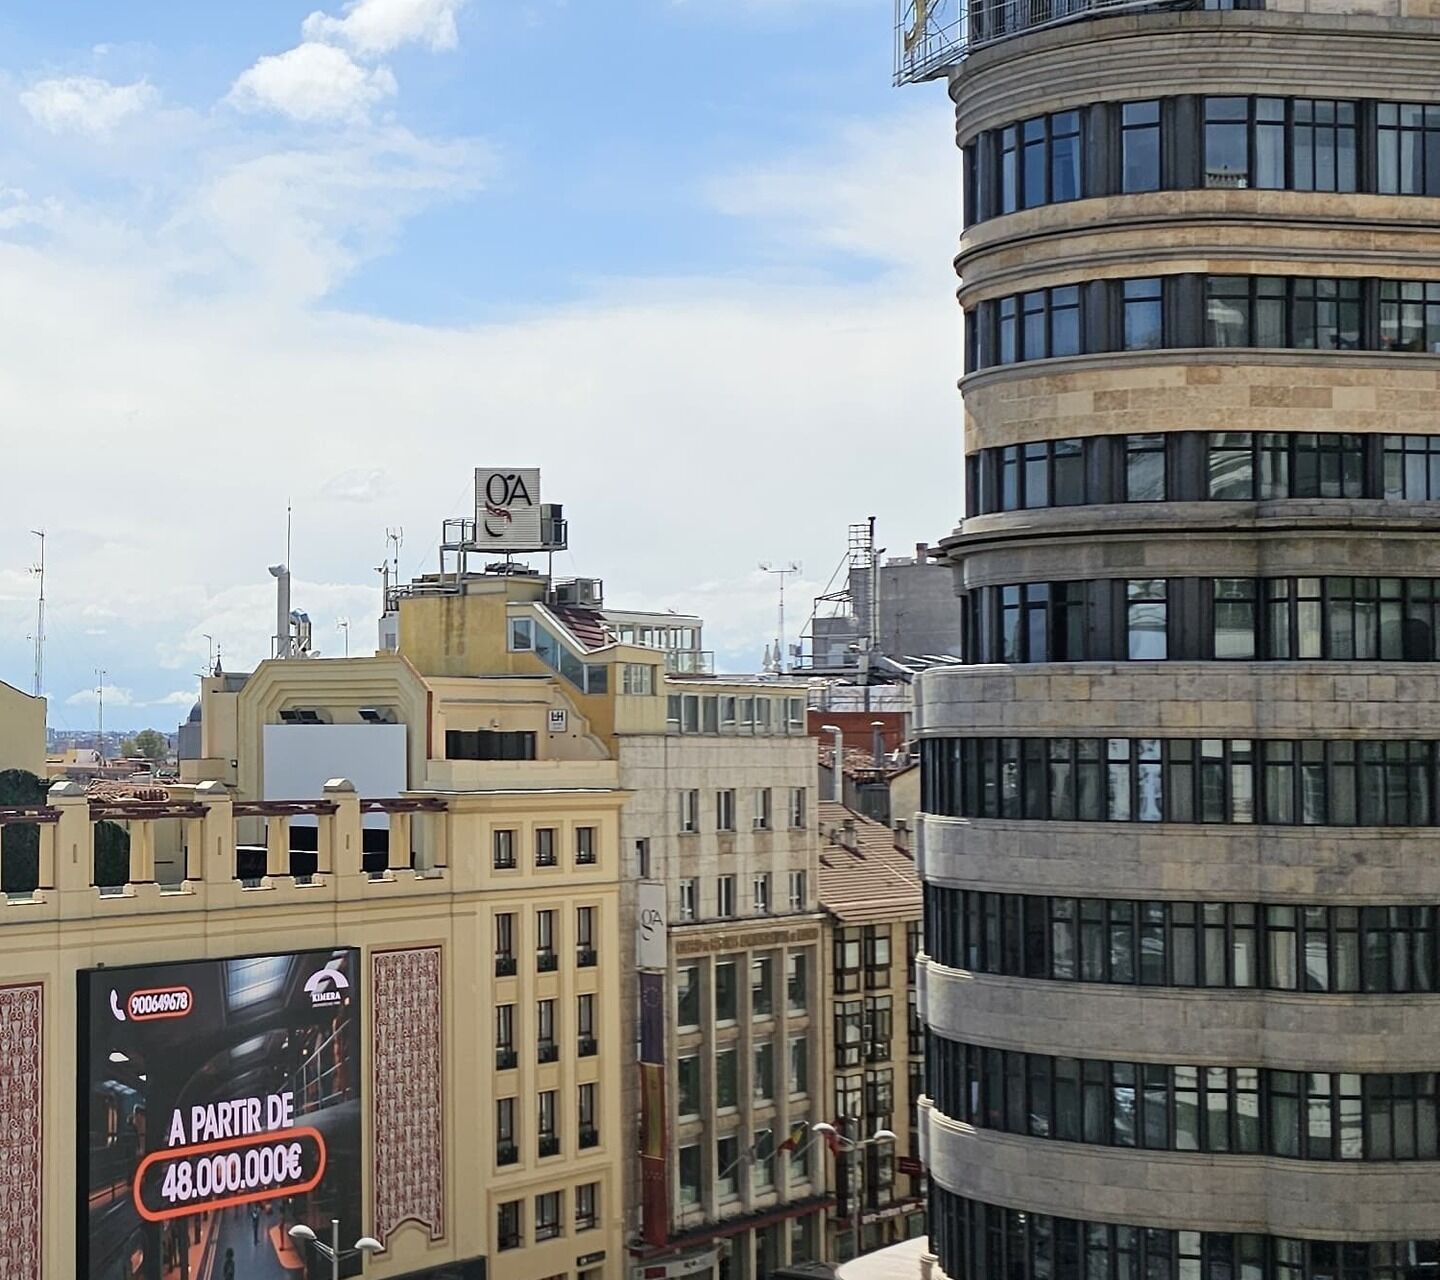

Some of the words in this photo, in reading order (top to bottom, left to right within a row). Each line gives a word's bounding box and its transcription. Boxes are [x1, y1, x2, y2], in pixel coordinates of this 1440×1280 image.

[132, 992, 188, 1014] 900649678
[169, 1109, 186, 1146] A
[267, 1091, 294, 1130] DE
[162, 1143, 302, 1202] 48.000.000€
